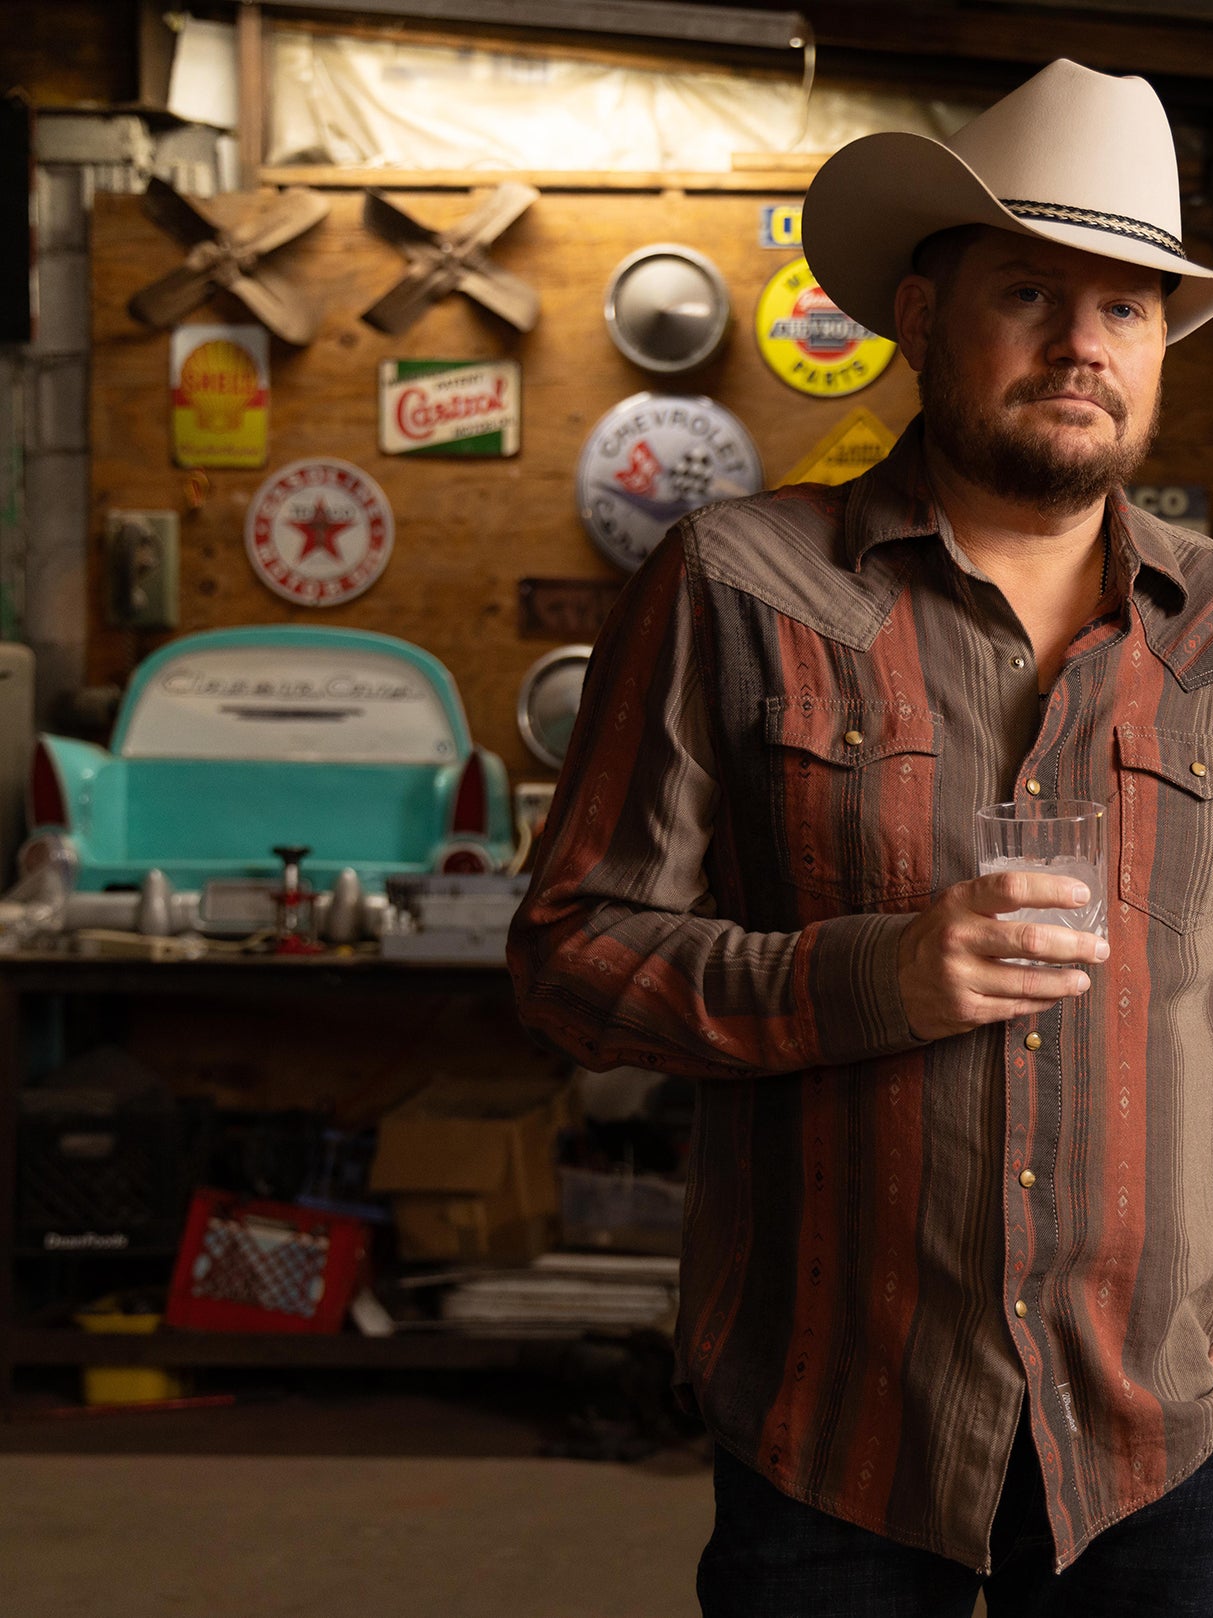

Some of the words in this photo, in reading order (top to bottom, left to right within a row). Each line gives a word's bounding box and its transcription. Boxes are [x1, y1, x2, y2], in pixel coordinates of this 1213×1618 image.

[181, 371, 259, 395] SHELL
[792, 360, 868, 387] PARTS
[397, 376, 507, 440] Castrol
[602, 407, 746, 473] CHEVROLET
[1062, 1391, 1077, 1432] Wrangler
